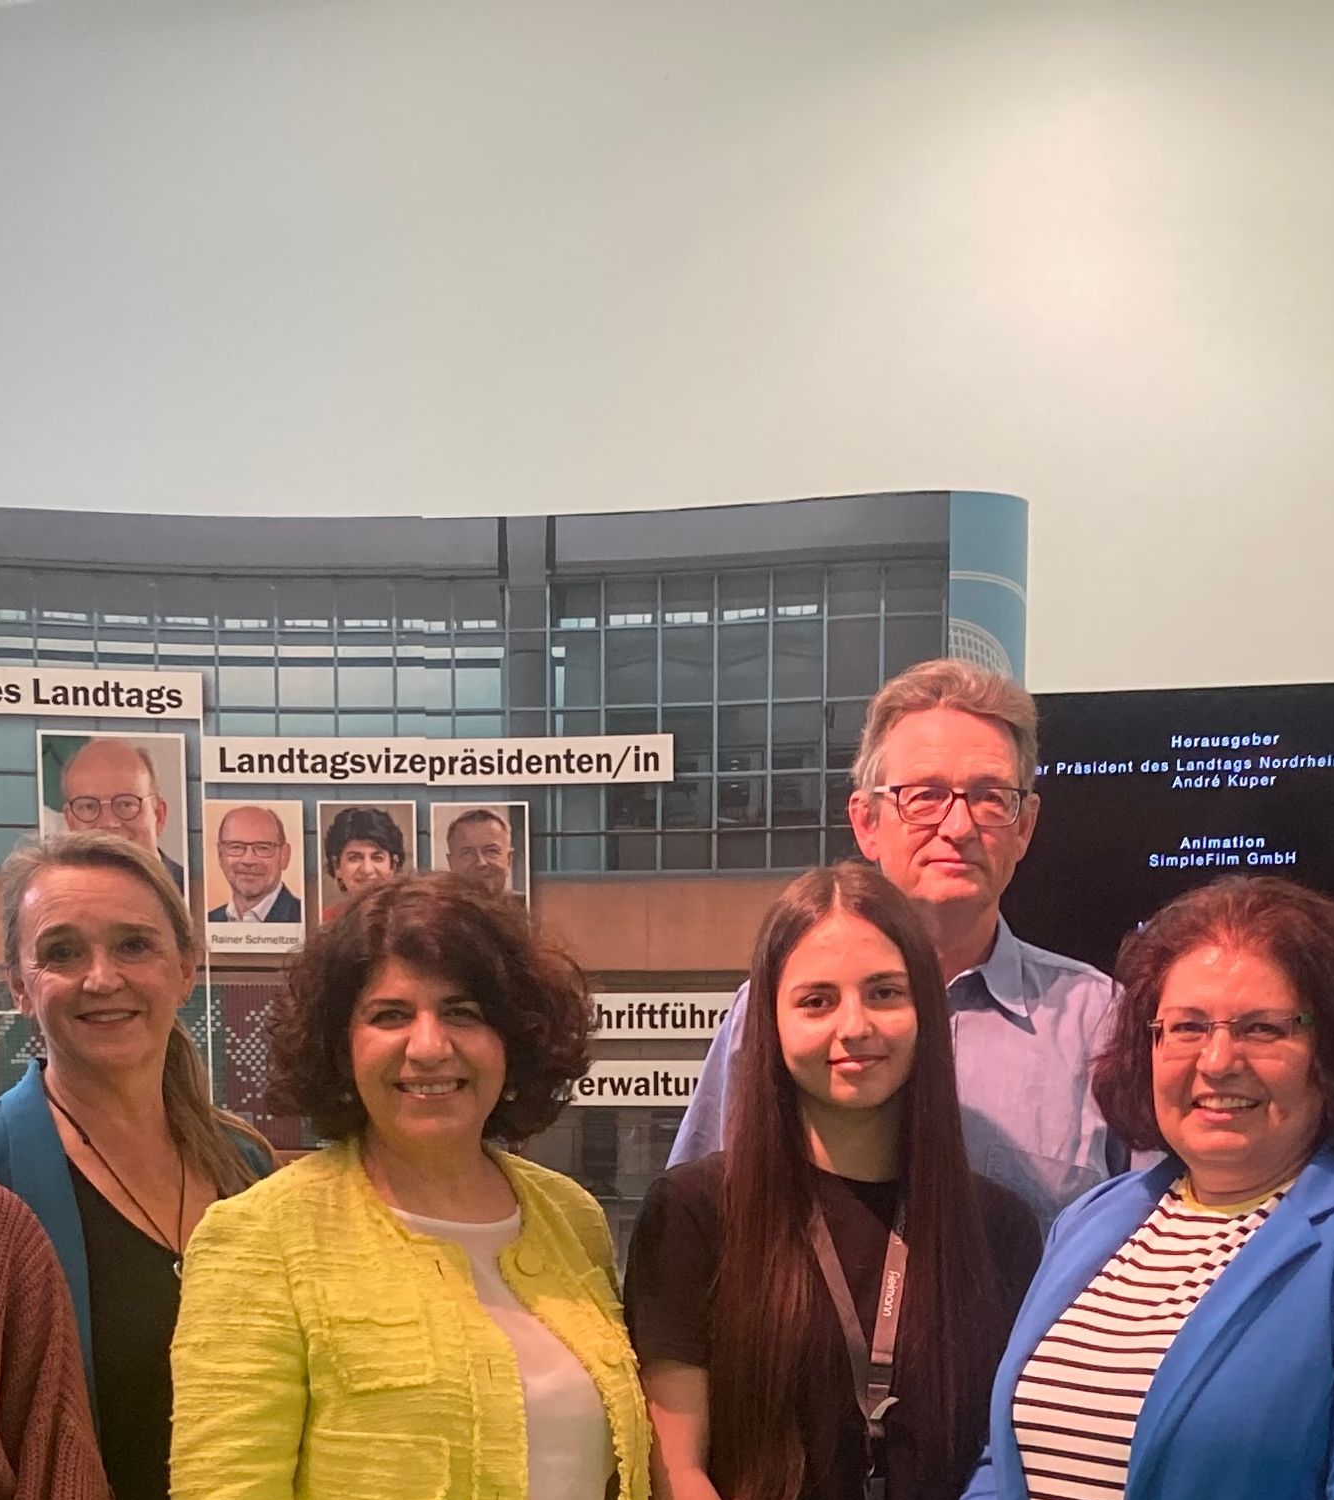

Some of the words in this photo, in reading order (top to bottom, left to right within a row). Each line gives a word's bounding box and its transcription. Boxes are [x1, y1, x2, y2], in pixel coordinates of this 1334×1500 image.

[32, 678, 184, 714] Landtags
[1171, 732, 1280, 750] Herausgeber
[218, 745, 661, 781] Landtagsvizepräsidenten/in
[1056, 760, 1134, 775] Präsident
[1140, 760, 1169, 773] des
[1176, 757, 1252, 773] Landtags
[1171, 774, 1221, 789] André
[1227, 774, 1277, 790] Kuper
[1179, 835, 1266, 849] Animation
[1148, 853, 1240, 869] SimpleFilm
[1247, 850, 1297, 865] GmbH
[211, 934, 243, 944] Rainer
